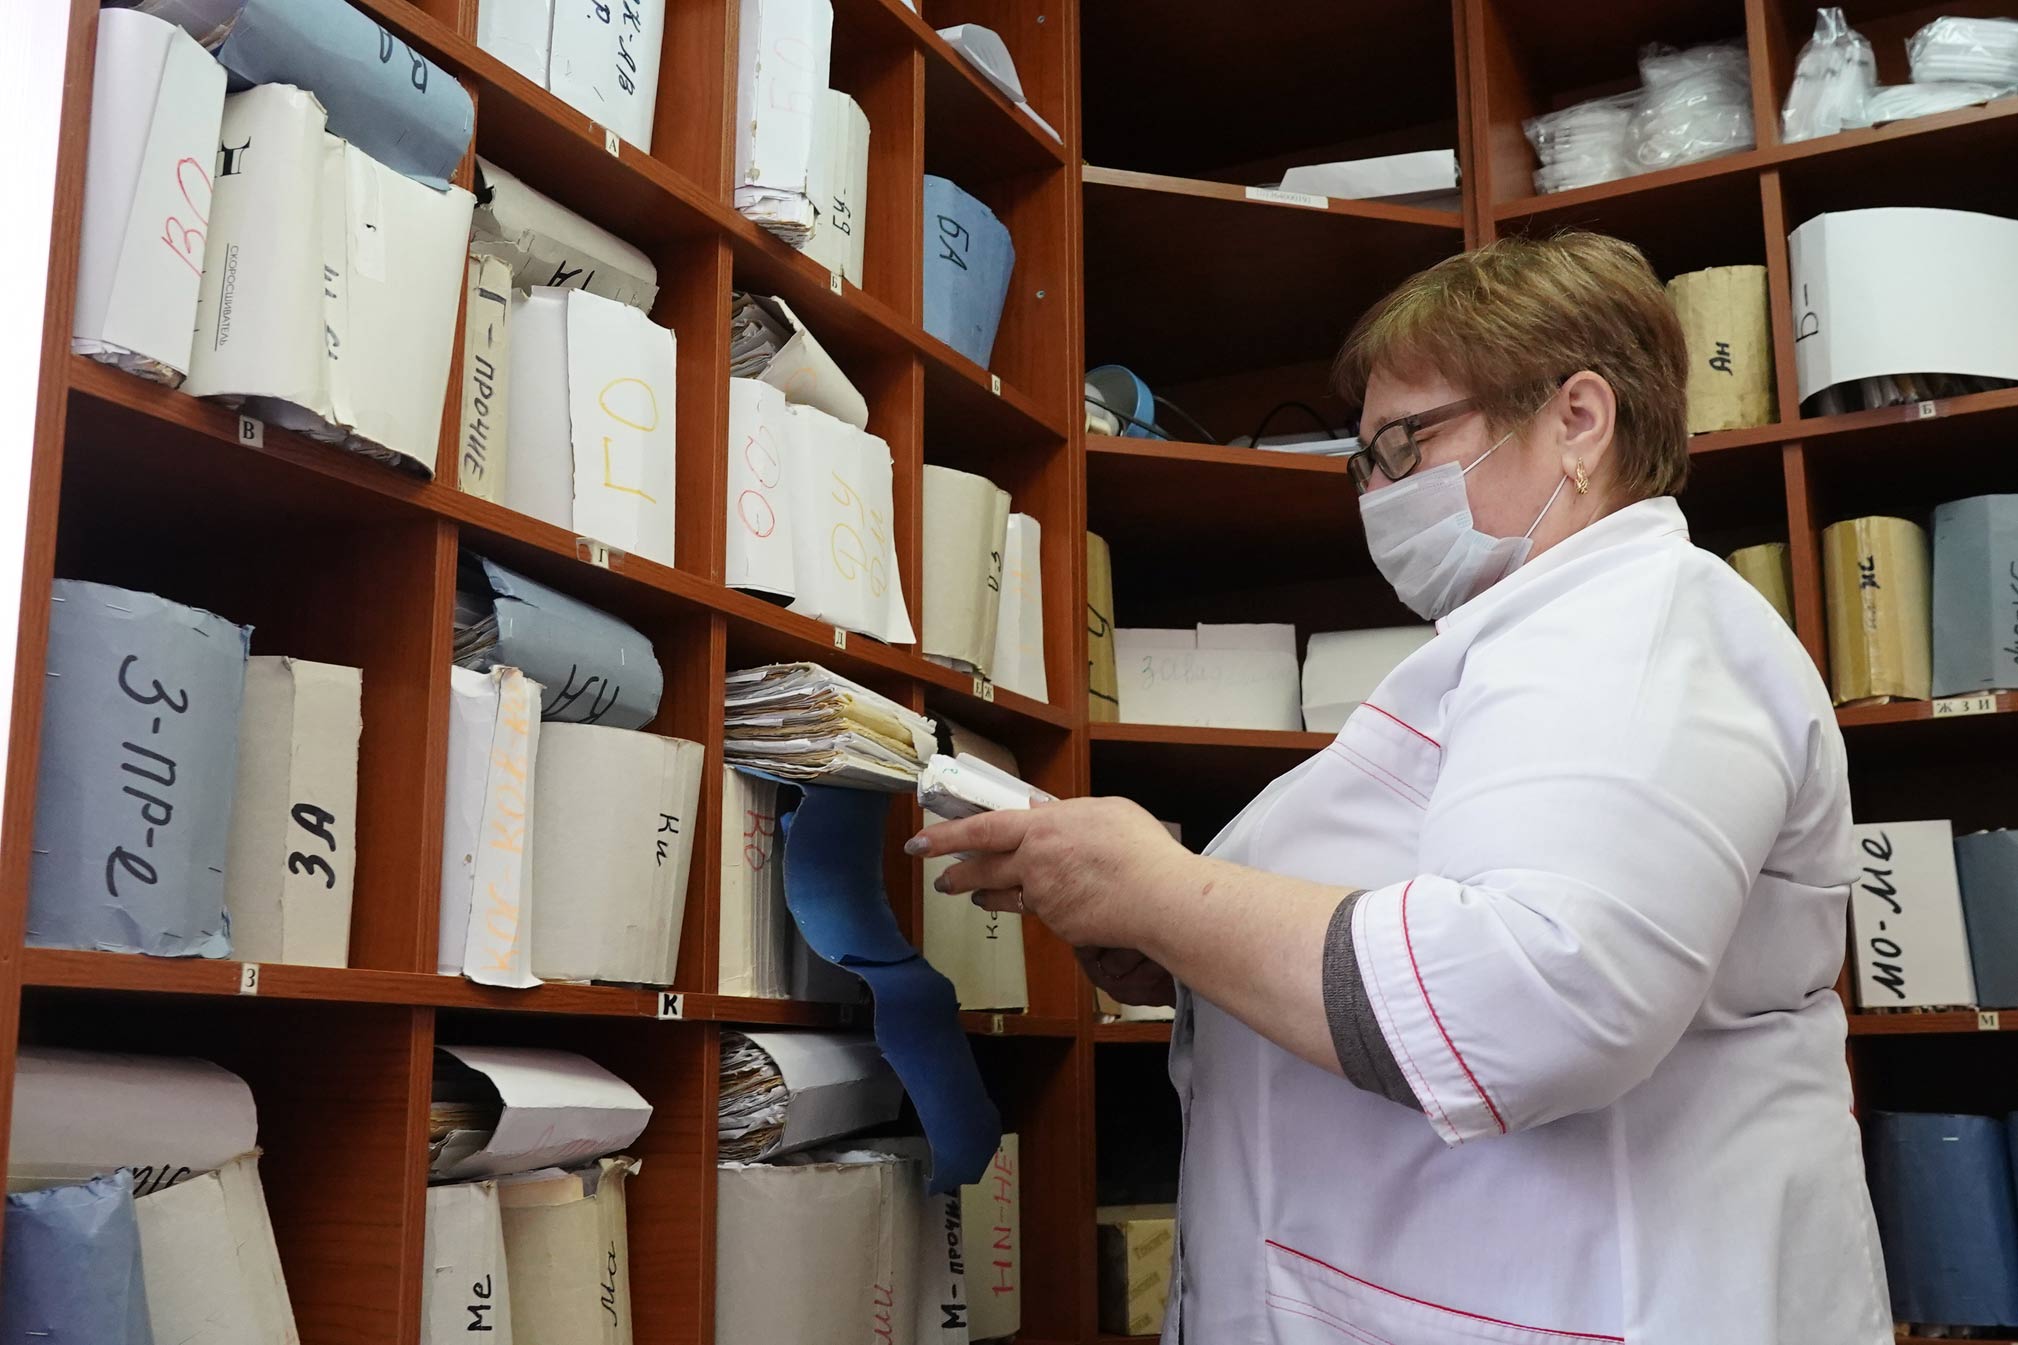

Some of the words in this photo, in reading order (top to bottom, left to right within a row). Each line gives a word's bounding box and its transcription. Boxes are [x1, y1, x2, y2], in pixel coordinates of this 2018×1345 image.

[219, 245, 239, 346] СКОРОСШИВАТЕЛЬ
[243, 420, 256, 440] В
[836, 632, 845, 648] Д
[1937, 702, 1952, 714] Ж
[1962, 701, 1971, 712] З
[1979, 699, 1990, 710] И
[663, 994, 678, 1016] К
[1981, 1013, 1995, 1027] М
